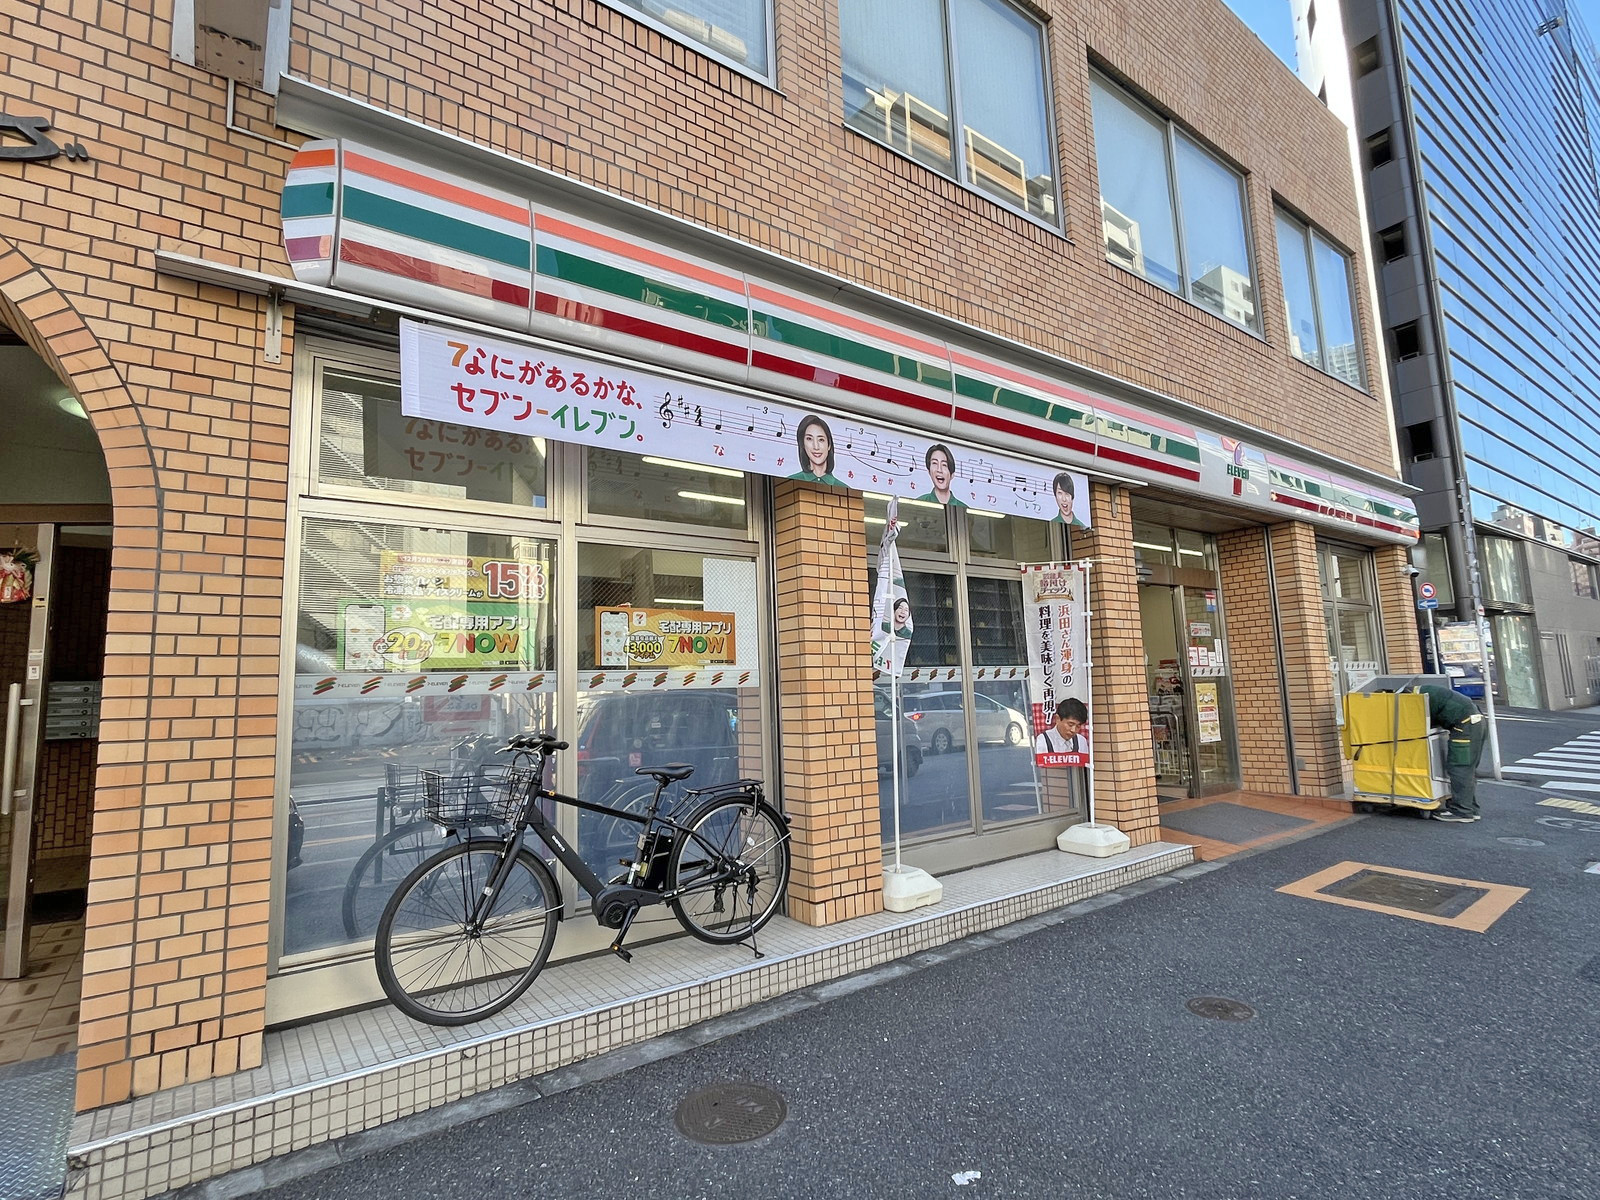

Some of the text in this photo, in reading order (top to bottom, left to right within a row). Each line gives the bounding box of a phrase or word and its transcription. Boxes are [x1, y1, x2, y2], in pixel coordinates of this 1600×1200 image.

[429, 615, 531, 631] 宅配専用アプリ
[658, 620, 732, 635] 宅配専用アプリ
[668, 634, 725, 654] 7NOW
[1057, 603, 1072, 685] 浜田さん渾身の
